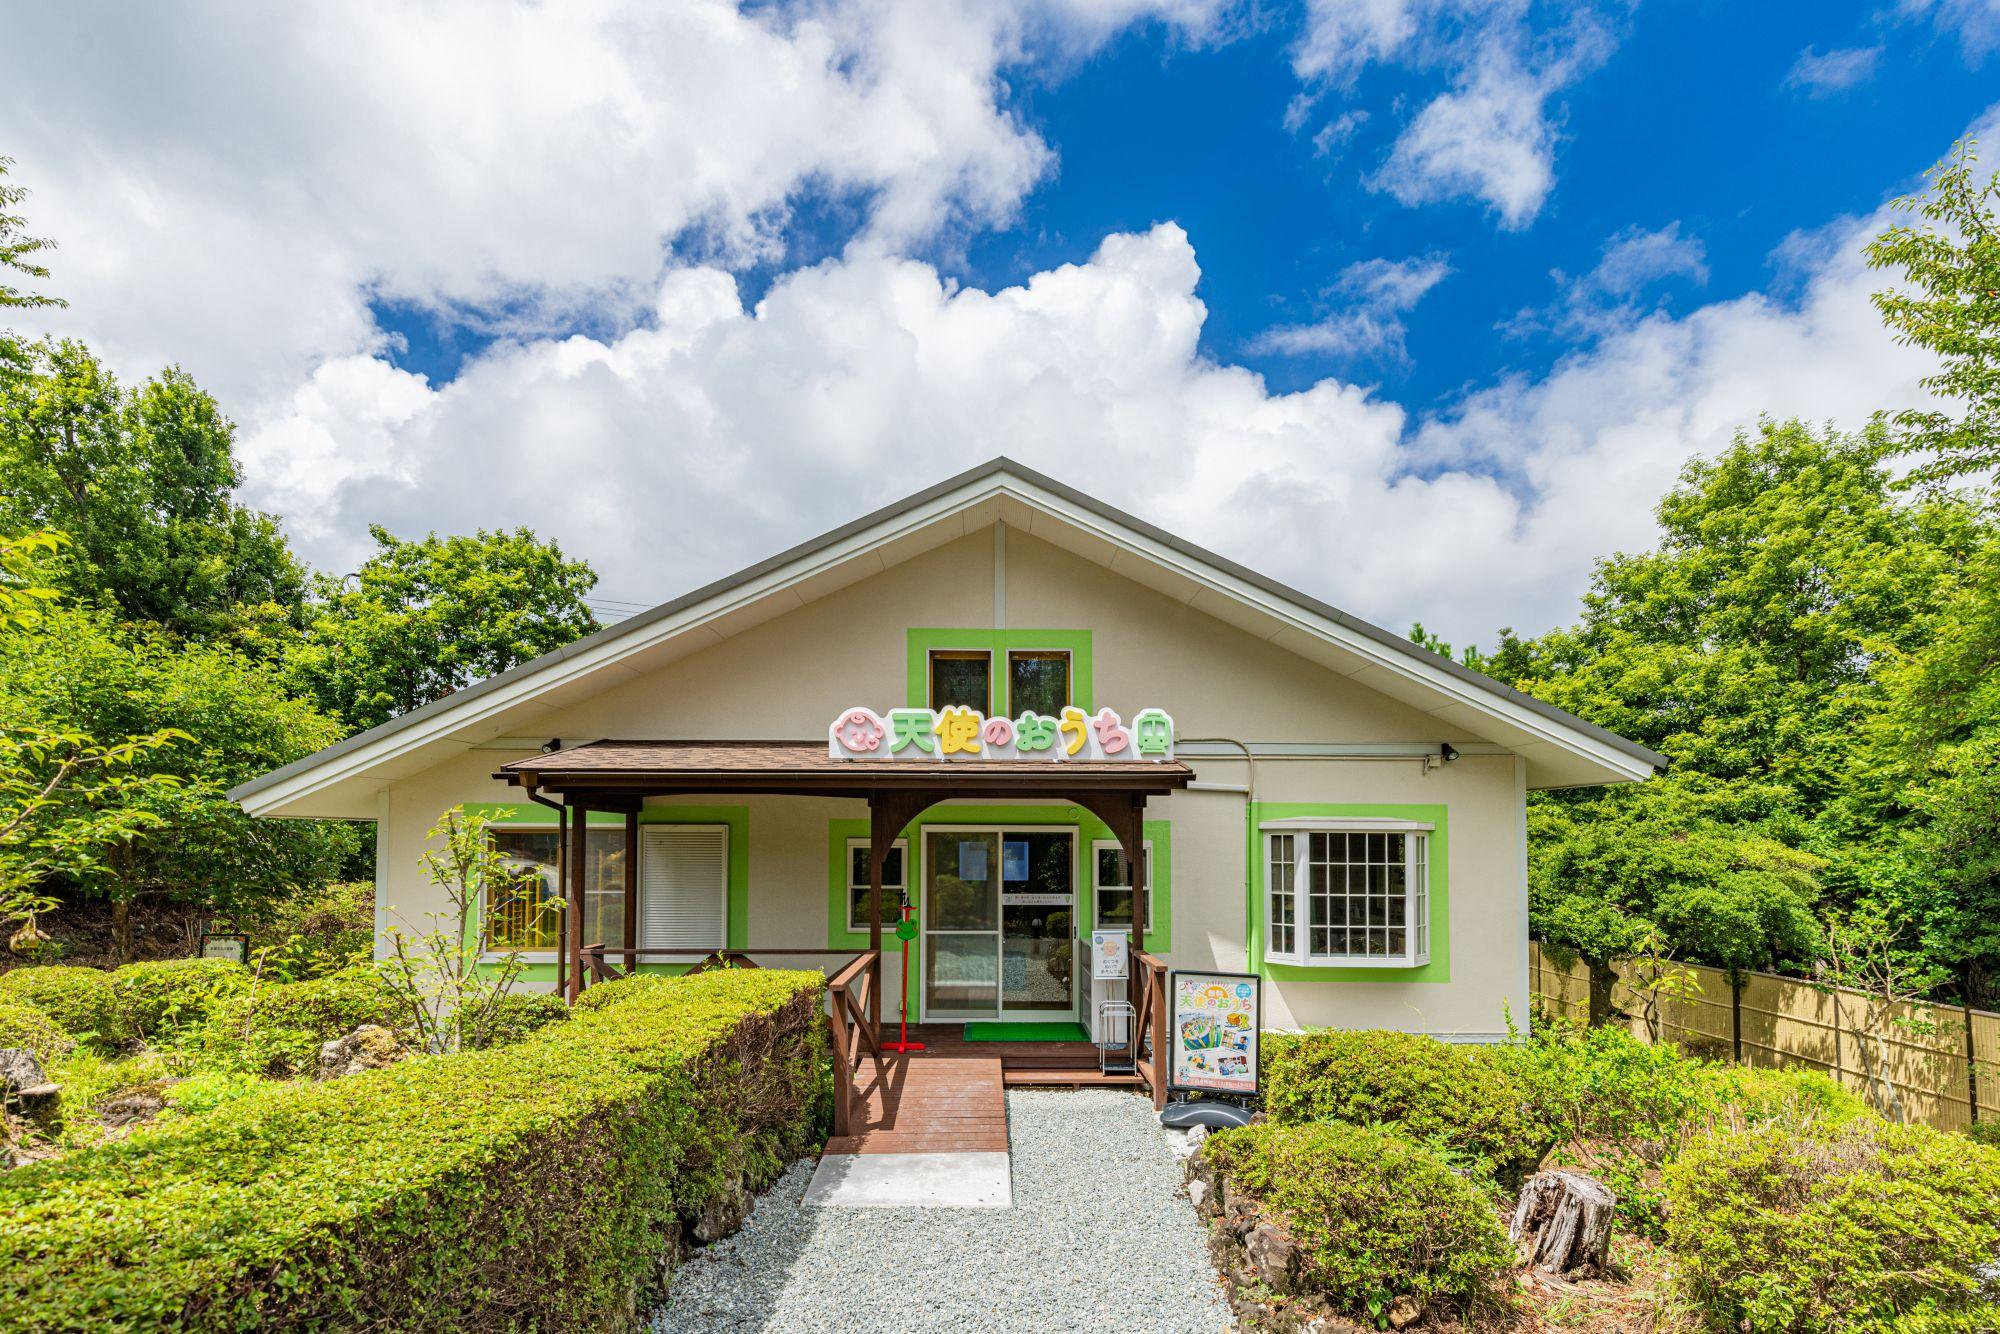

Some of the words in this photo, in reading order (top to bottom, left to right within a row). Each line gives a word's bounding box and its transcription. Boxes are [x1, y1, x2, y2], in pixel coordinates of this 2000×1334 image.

[890, 708, 1129, 755] 天使のおうち
[1180, 994, 1252, 1011] 天使のおうち
